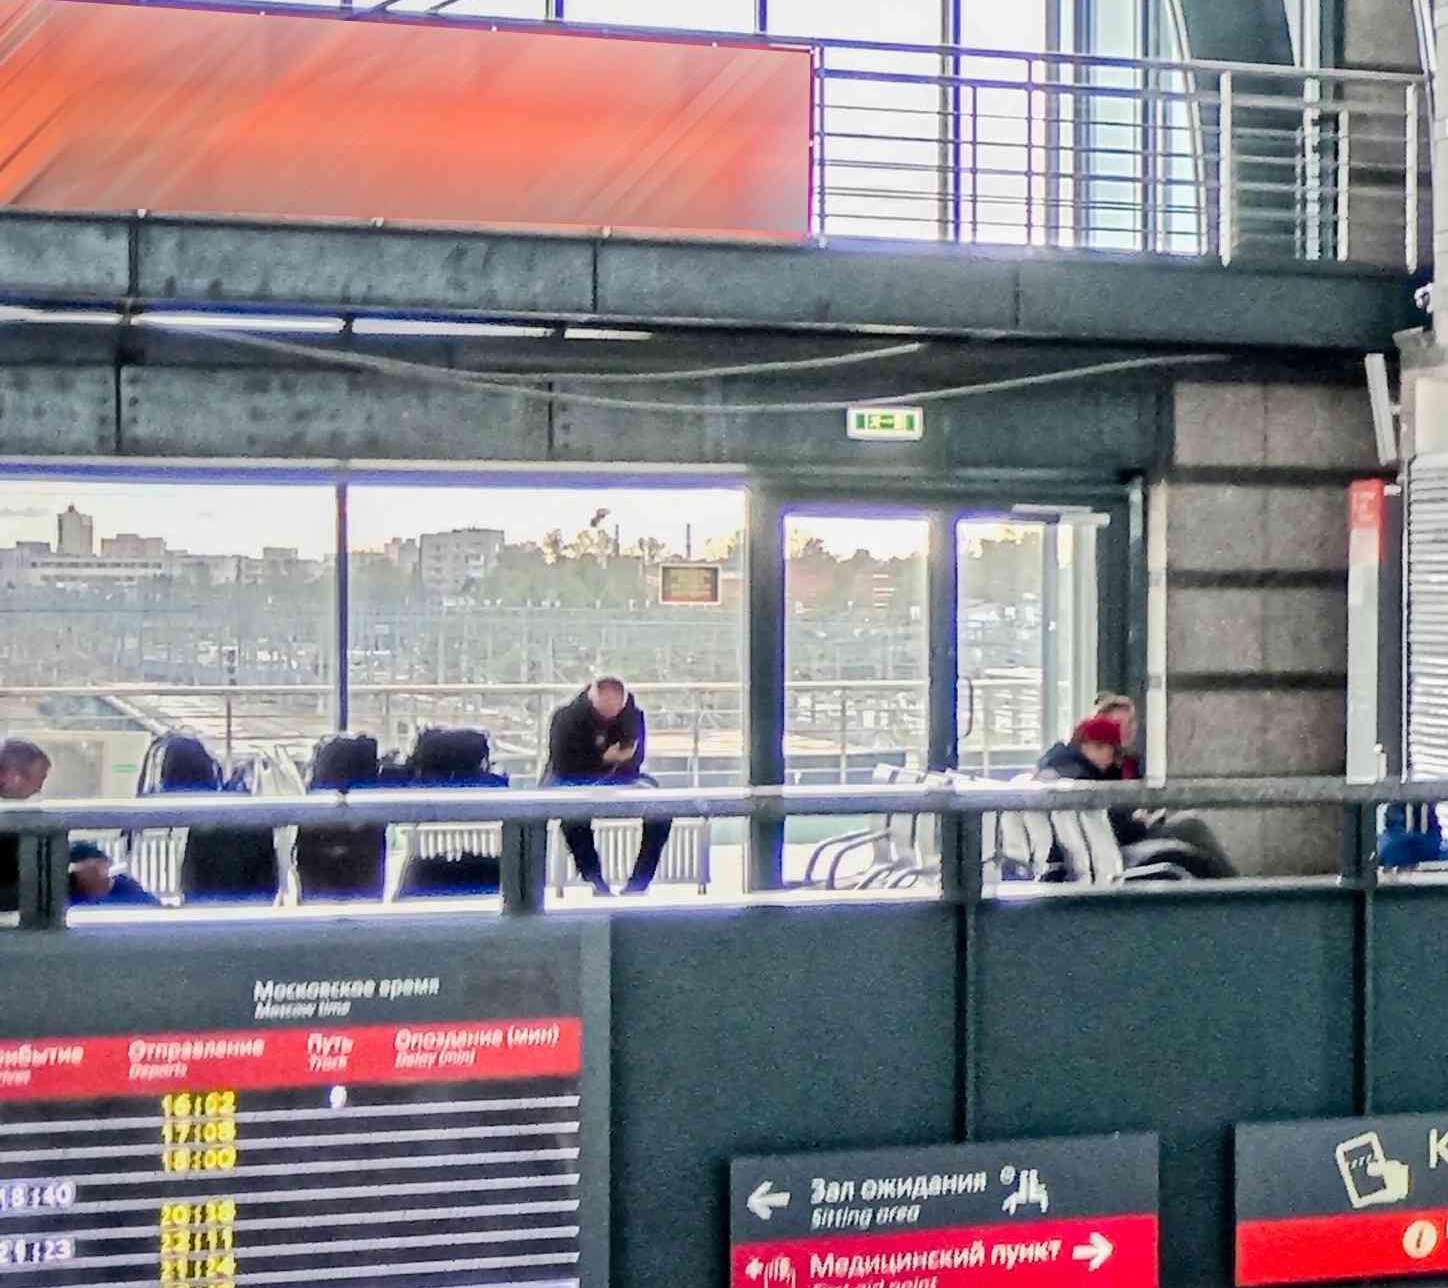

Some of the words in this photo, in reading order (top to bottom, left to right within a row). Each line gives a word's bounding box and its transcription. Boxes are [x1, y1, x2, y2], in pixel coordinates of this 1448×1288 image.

[810, 1177, 854, 1204] Зал
[861, 1171, 987, 1202] ожидания
[809, 1241, 985, 1280] Медицинский
[991, 1238, 1062, 1271] пункт
